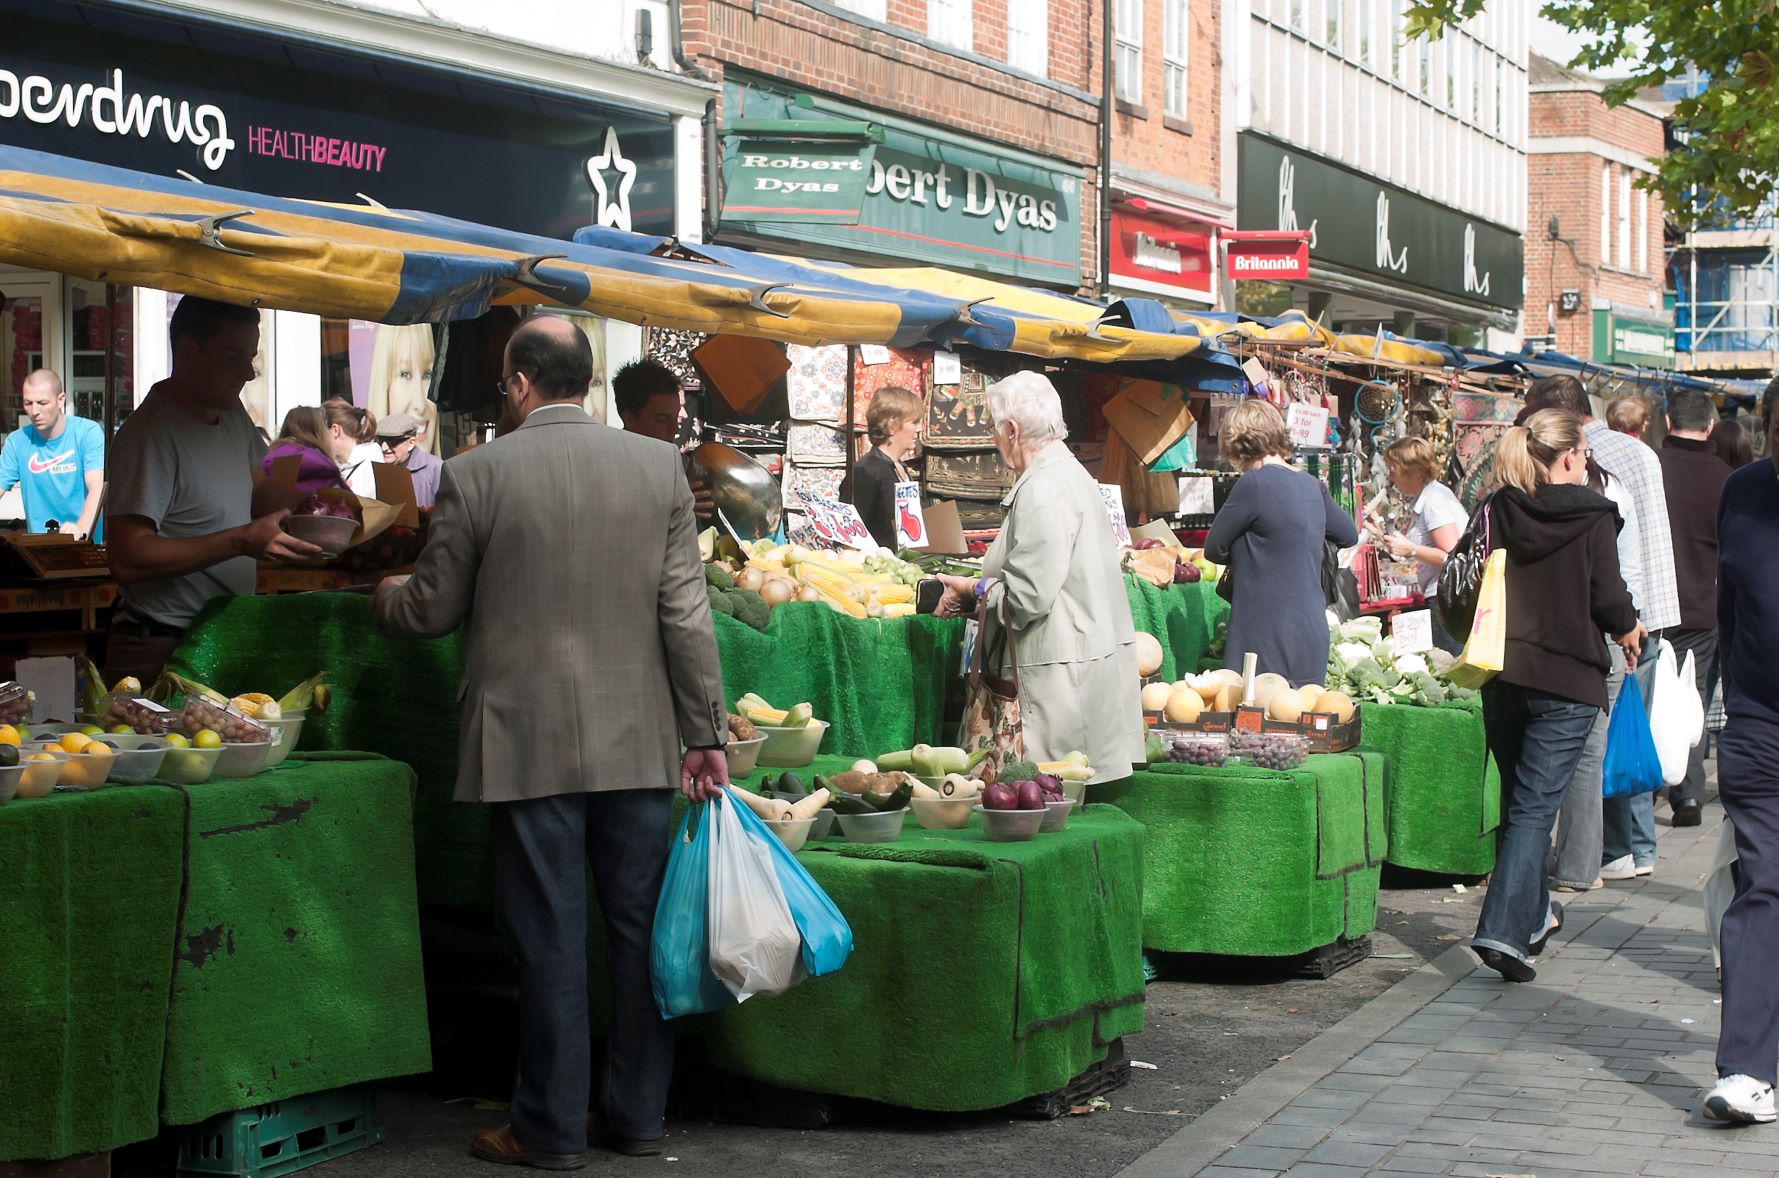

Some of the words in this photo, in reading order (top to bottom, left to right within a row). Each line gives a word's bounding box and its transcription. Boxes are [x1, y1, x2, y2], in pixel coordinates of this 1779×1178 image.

[248, 125, 387, 172] HEALTHBEAUTY
[741, 154, 864, 171] Robert
[753, 177, 840, 193] Dyas
[962, 166, 1057, 233] Dyas
[1234, 255, 1299, 271] Britannia
